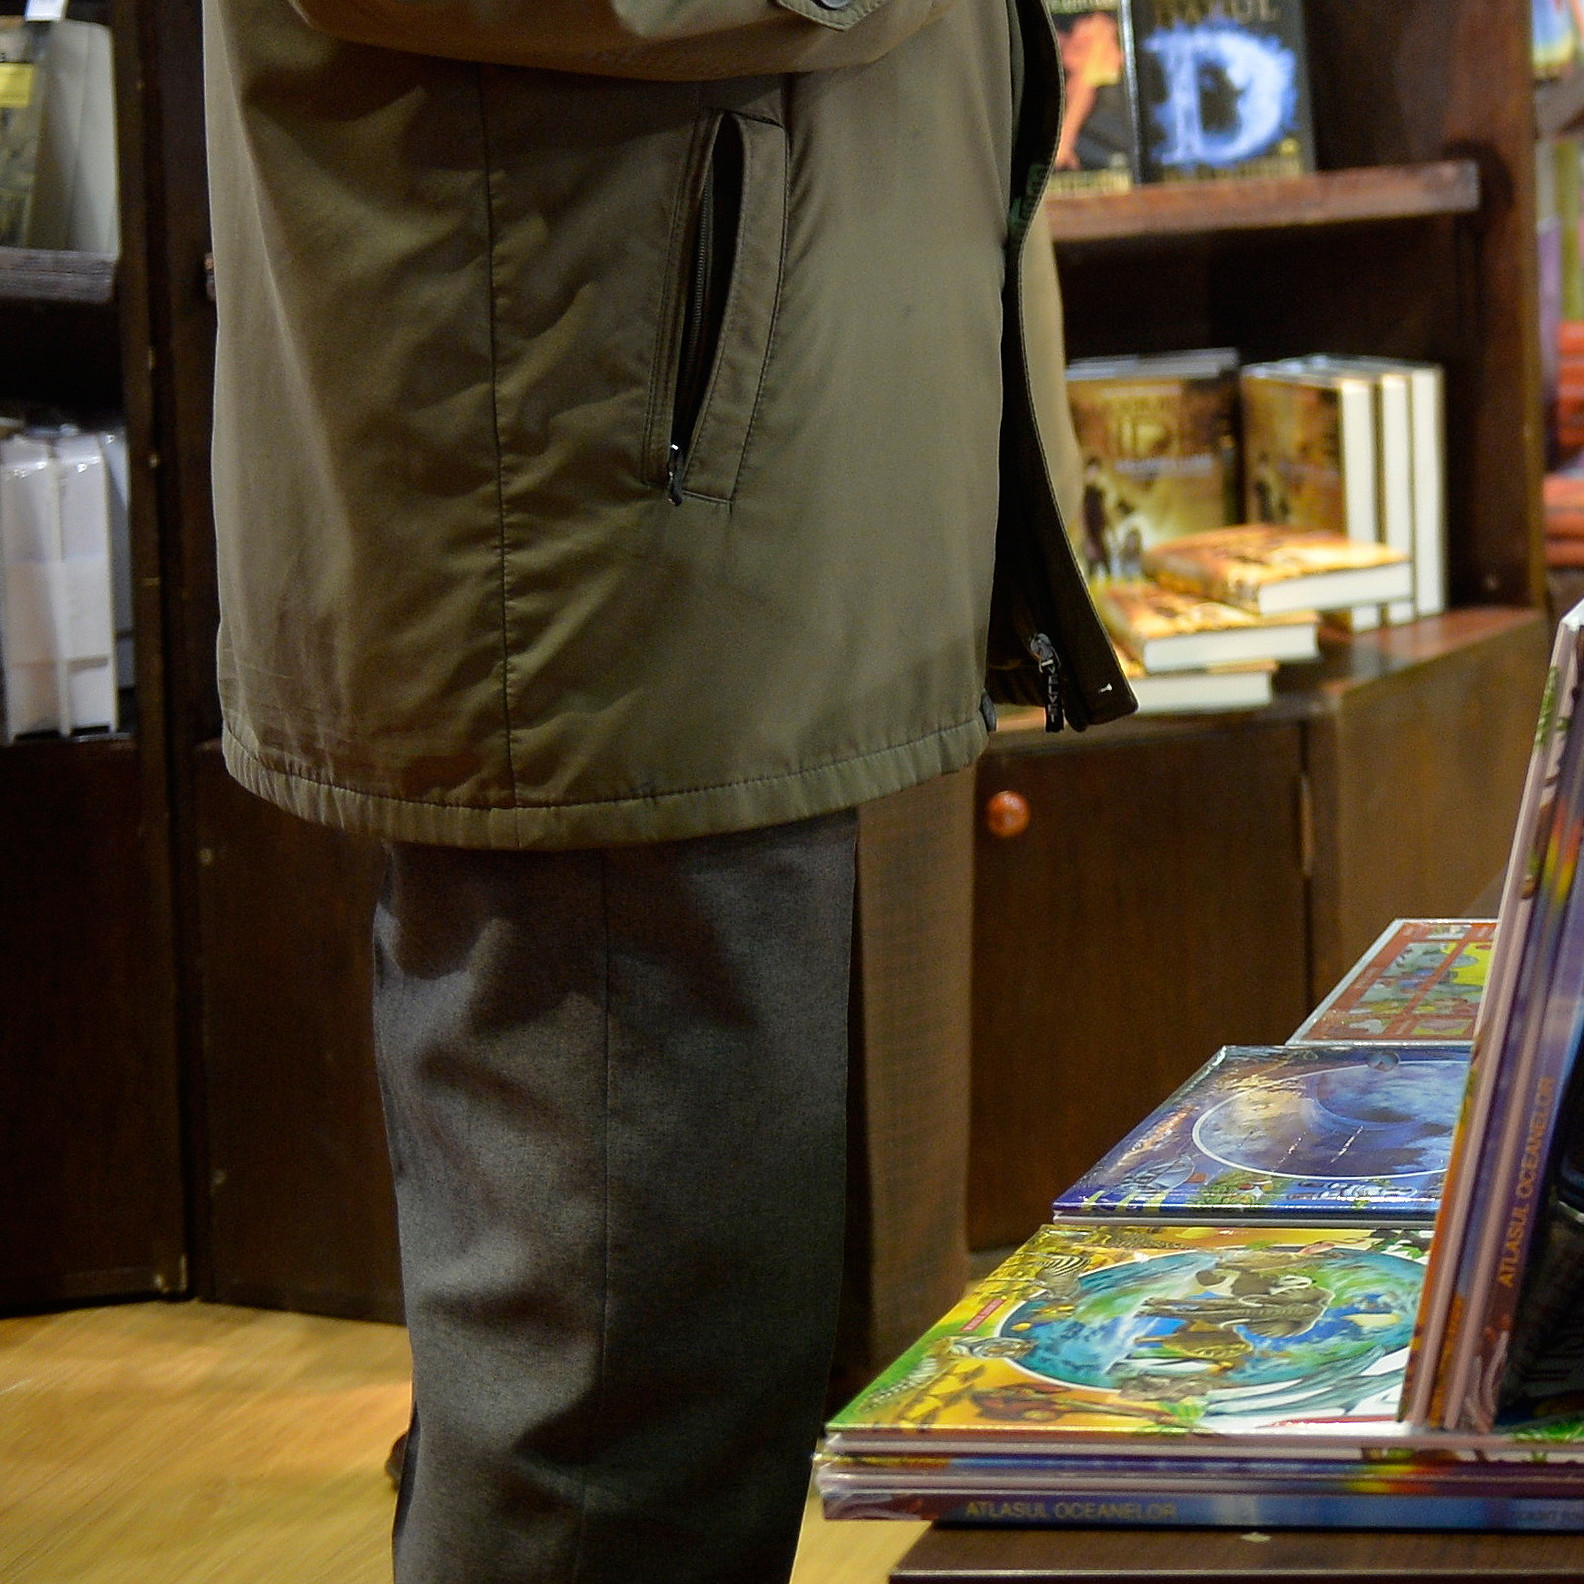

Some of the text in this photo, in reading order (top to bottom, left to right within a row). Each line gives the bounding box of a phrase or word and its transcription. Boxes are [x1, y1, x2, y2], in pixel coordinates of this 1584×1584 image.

[1496, 1193, 1534, 1289] ATLASUL
[965, 1501, 1179, 1520] ATLASUL OCEANELOR
